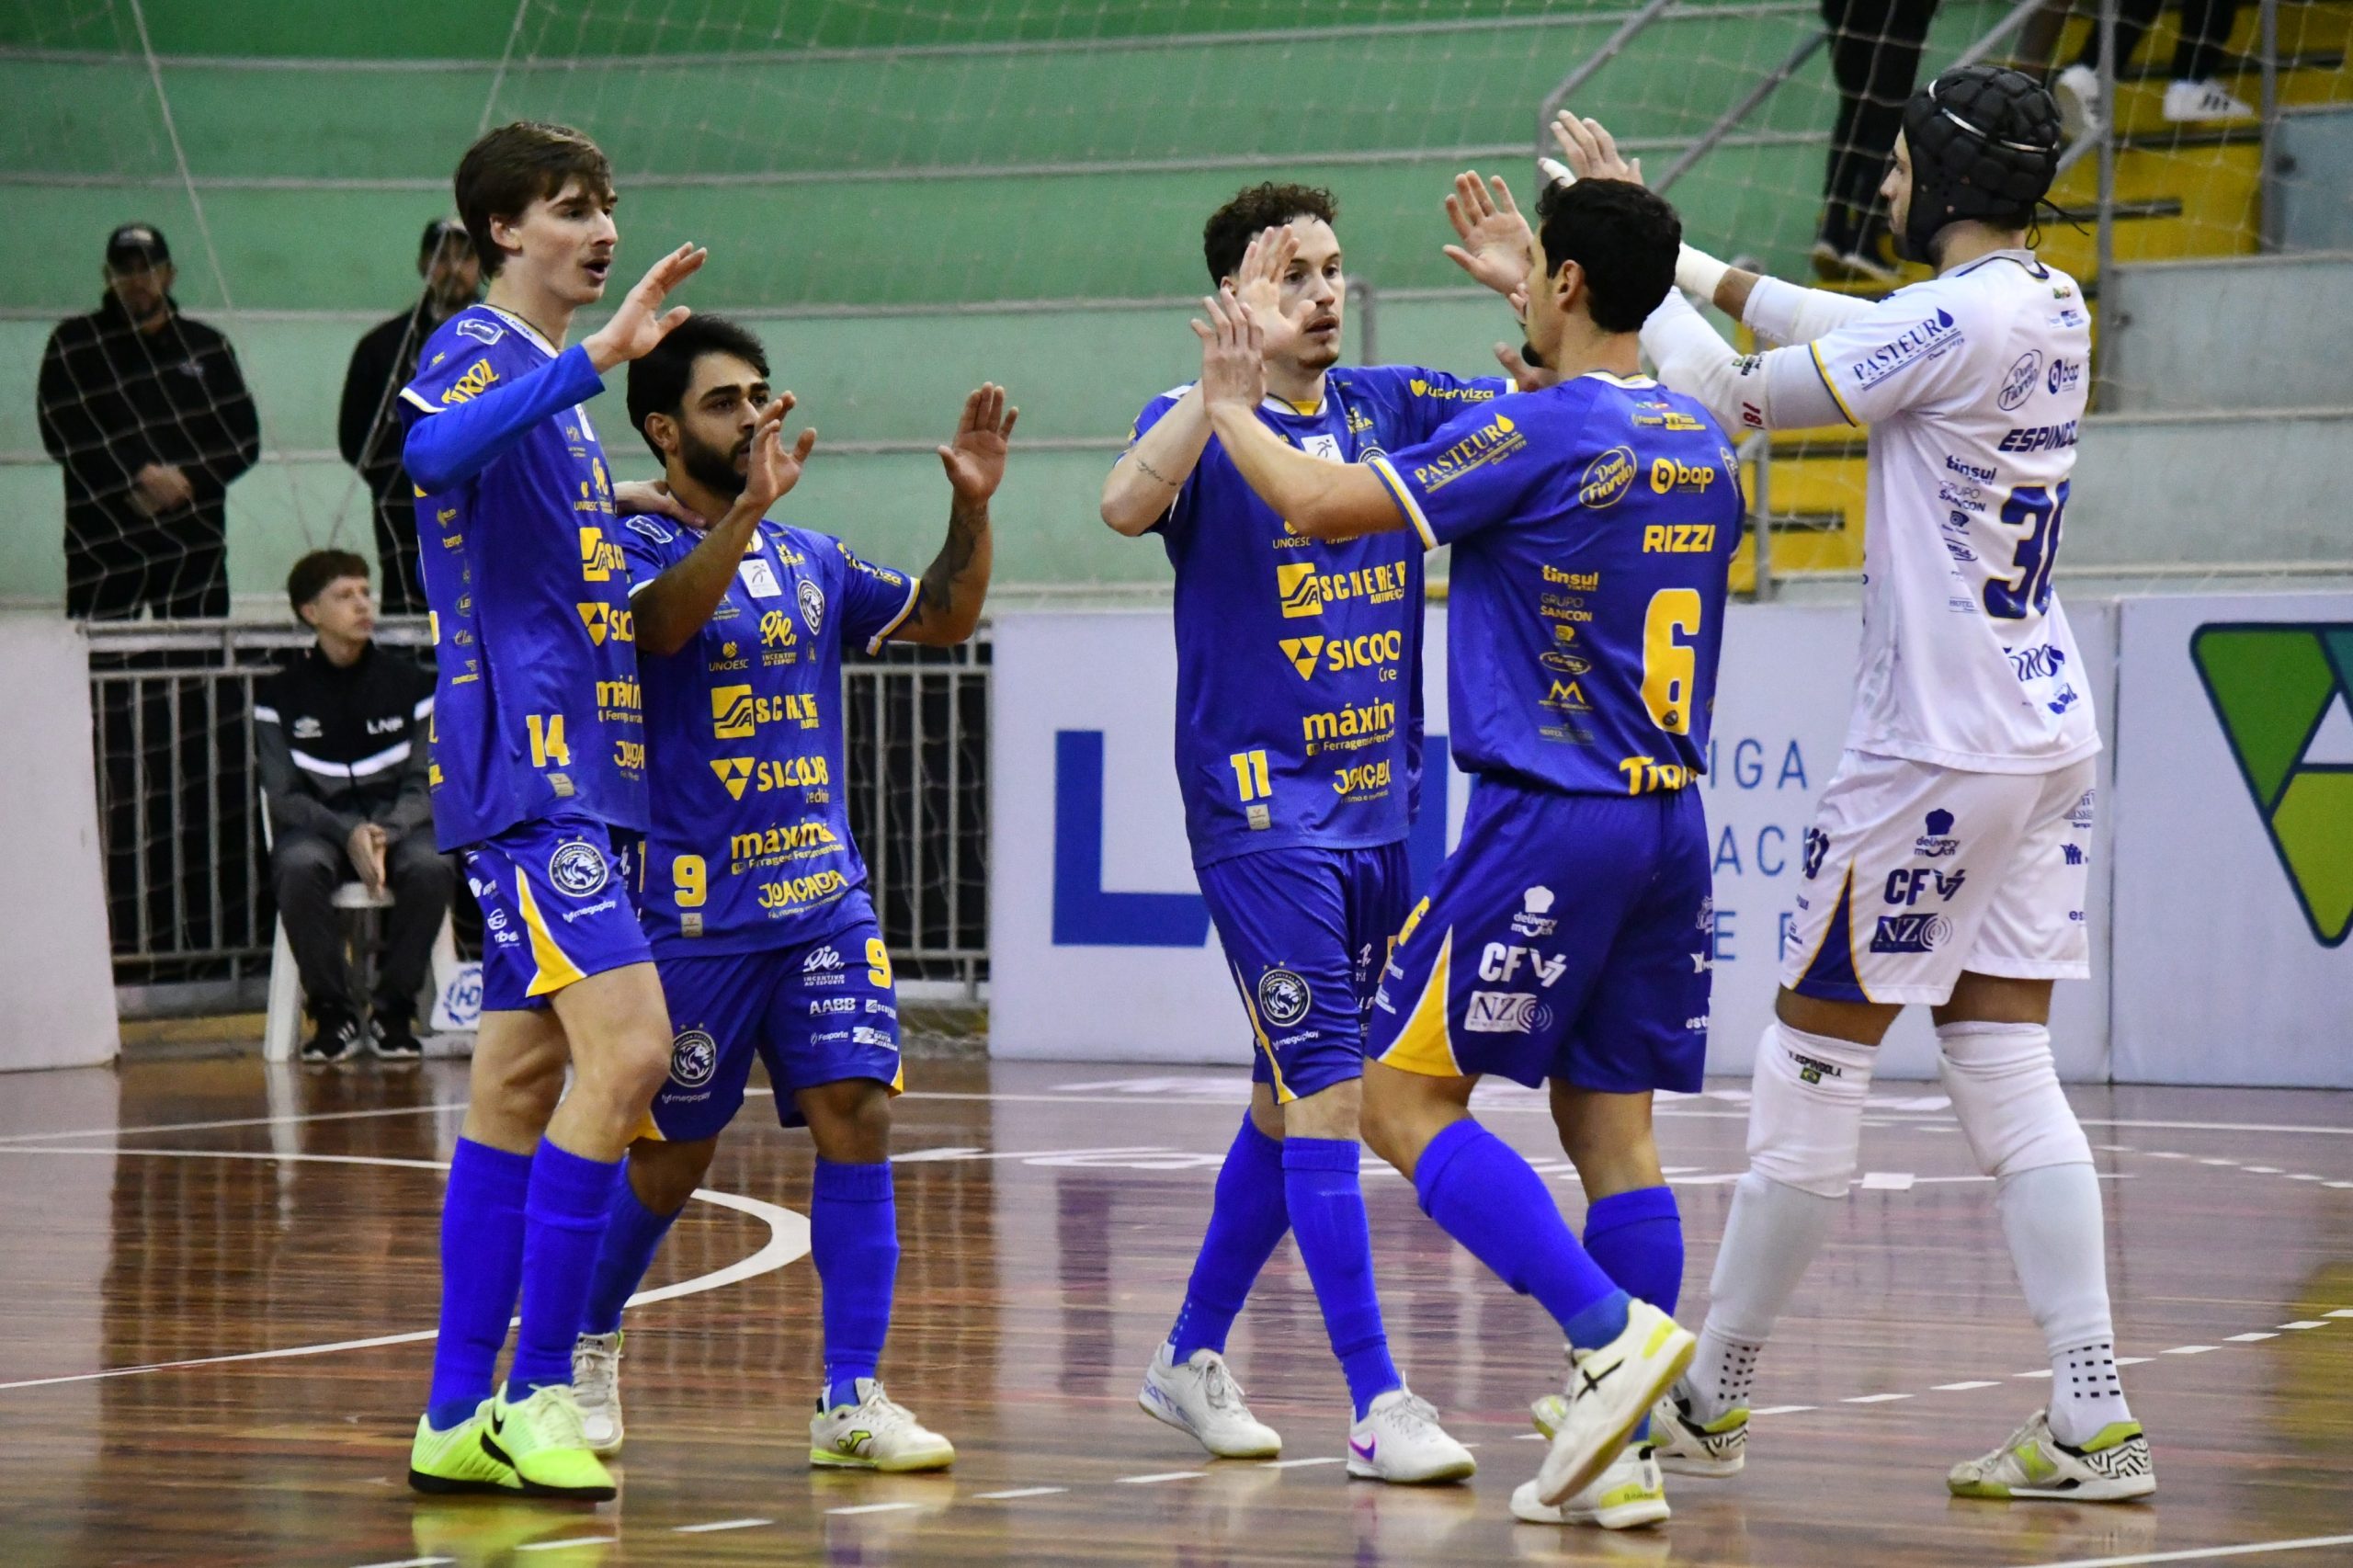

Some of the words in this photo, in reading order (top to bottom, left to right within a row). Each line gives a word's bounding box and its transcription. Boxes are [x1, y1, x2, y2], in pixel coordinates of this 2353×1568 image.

[1852, 319, 1942, 381] PASTEUR
[1414, 424, 1505, 484] PASTEUR
[1945, 454, 1997, 481] tinsul
[1643, 524, 1717, 553] RIZZI
[1540, 592, 1584, 608] GRUPO
[1541, 564, 1600, 586] tinsul
[709, 658, 749, 672] UNOESC
[1325, 630, 1403, 672] SICOO
[1641, 587, 1702, 736] 6
[525, 713, 571, 768] 14
[1710, 738, 1809, 790] IGA
[1229, 749, 1273, 802] 11
[672, 854, 708, 908] 9
[865, 937, 892, 990] 9
[809, 996, 857, 1015] AABB
